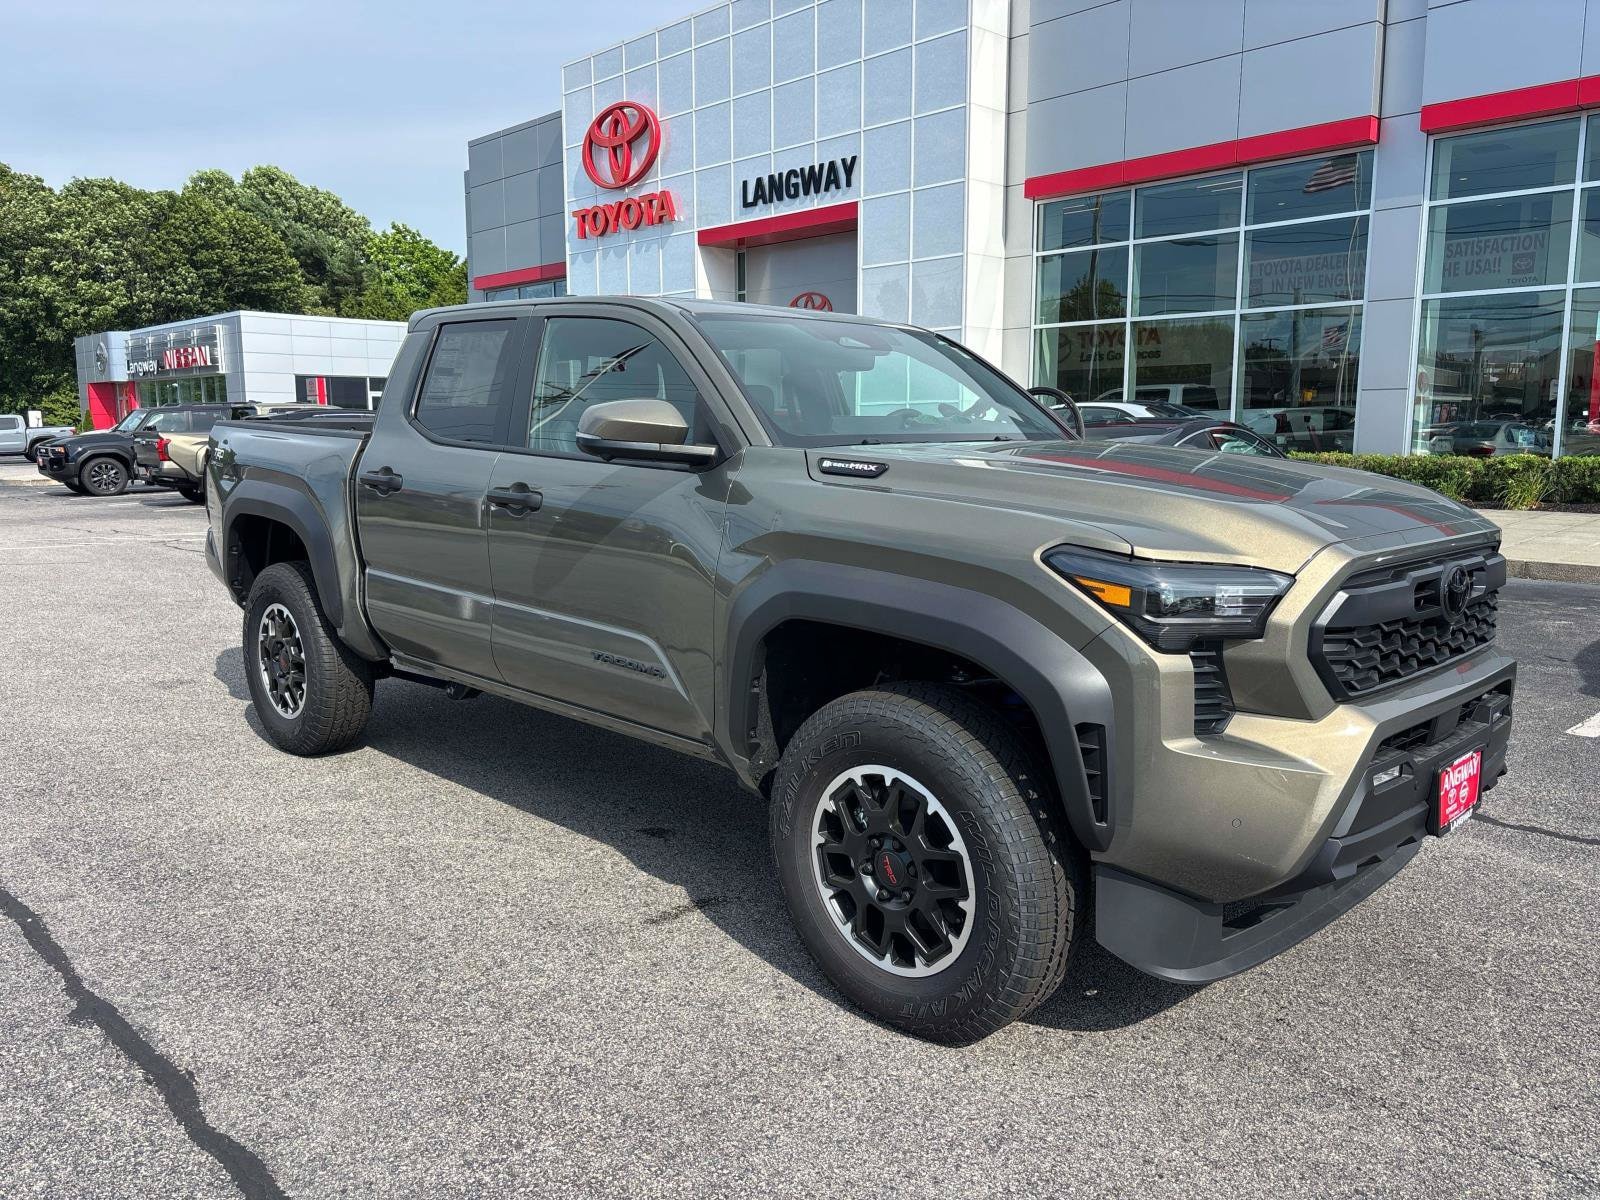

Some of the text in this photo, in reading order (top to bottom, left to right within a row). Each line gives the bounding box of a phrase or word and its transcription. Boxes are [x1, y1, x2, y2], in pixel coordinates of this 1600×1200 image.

[742, 155, 858, 209] LANGWAY
[572, 190, 677, 240] TOYOTA
[1445, 231, 1546, 258] SATISFACTION
[1260, 258, 1304, 276] TOYOTA
[1287, 275, 1314, 291] NEW
[1318, 270, 1365, 289] ENGLAN
[1443, 260, 1460, 278] HE
[126, 345, 212, 376] Langway NISSAN
[591, 648, 668, 679] TACOMA
[780, 730, 862, 840] FALKEN
[882, 854, 898, 886] TRD
